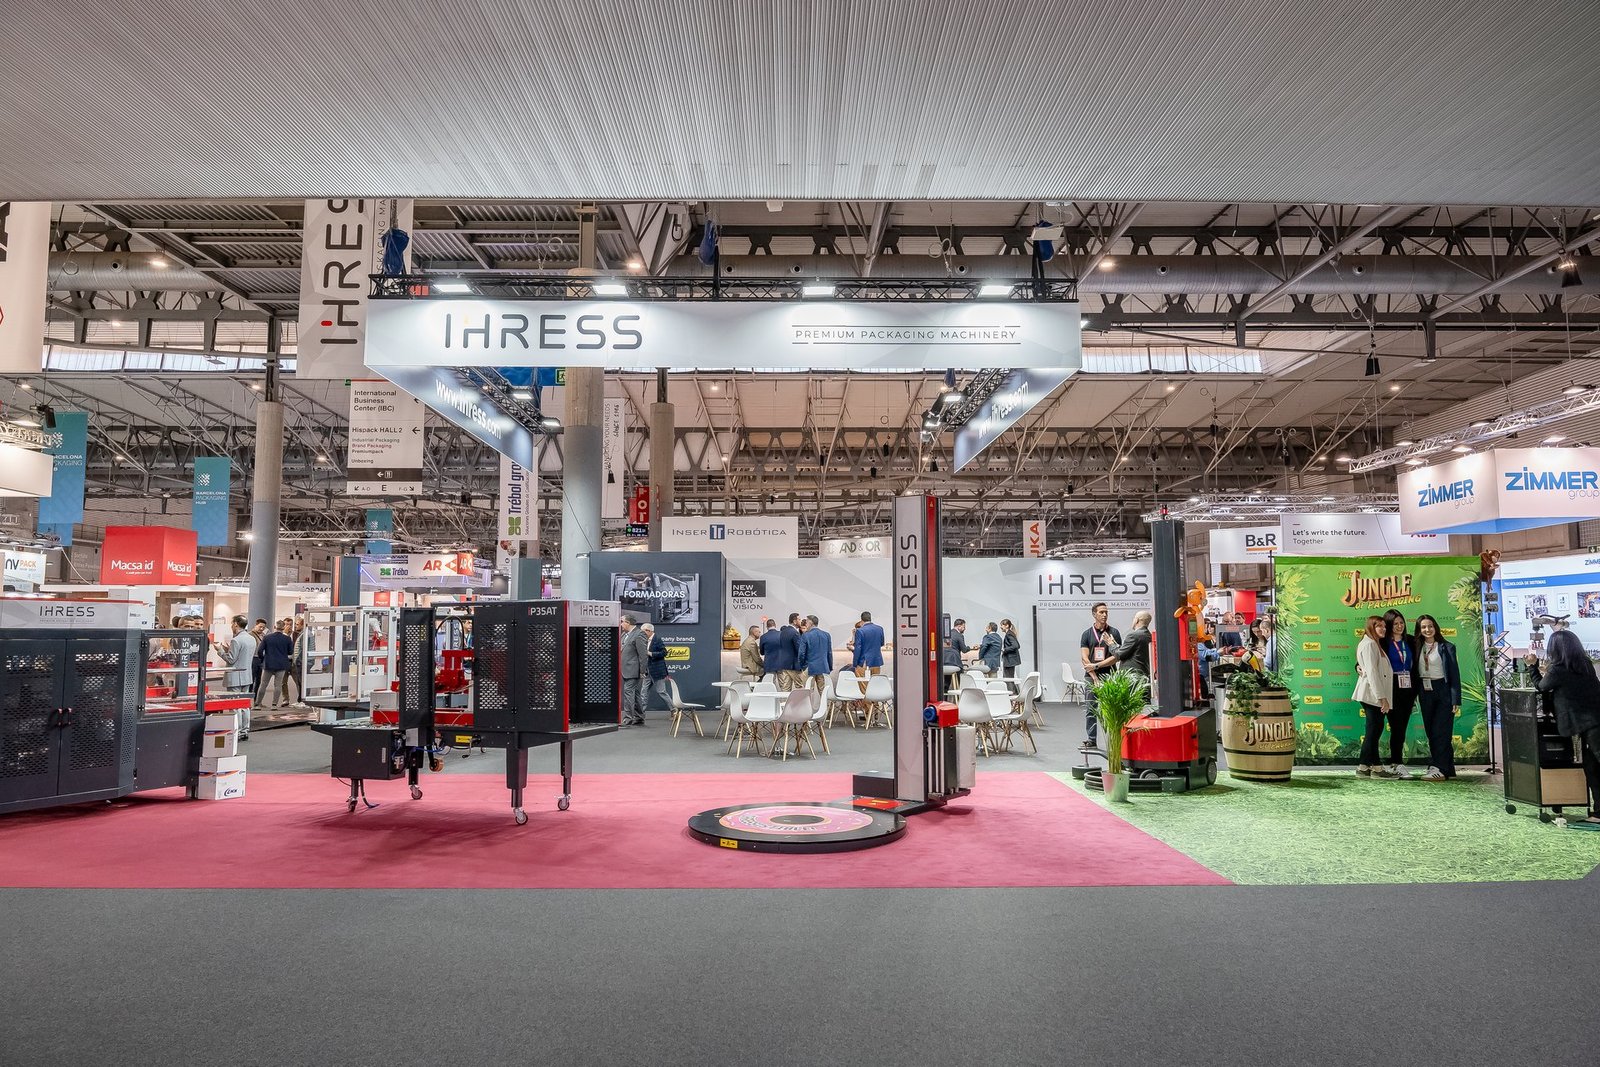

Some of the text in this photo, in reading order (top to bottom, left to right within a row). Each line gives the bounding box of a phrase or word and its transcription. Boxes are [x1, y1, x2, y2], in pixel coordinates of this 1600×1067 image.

[445, 313, 643, 349] IHRESS
[795, 330, 1016, 339] PREMIUM PACKAGING MACHINERY
[508, 461, 525, 514] Trébol gro
[1568, 489, 1600, 500] group
[1454, 496, 1475, 509] group
[1245, 533, 1277, 547] B&R
[111, 560, 154, 570] Macsa id
[167, 561, 186, 572] Macsa
[901, 534, 918, 637] IHRESS
[1039, 574, 1149, 595] IHRESS
[1341, 570, 1413, 607] JUNGLE
[624, 590, 686, 598] FORMADORAS
[39, 605, 95, 617] IHRESS
[580, 605, 610, 616] IHRESS
[901, 647, 919, 656] i200
